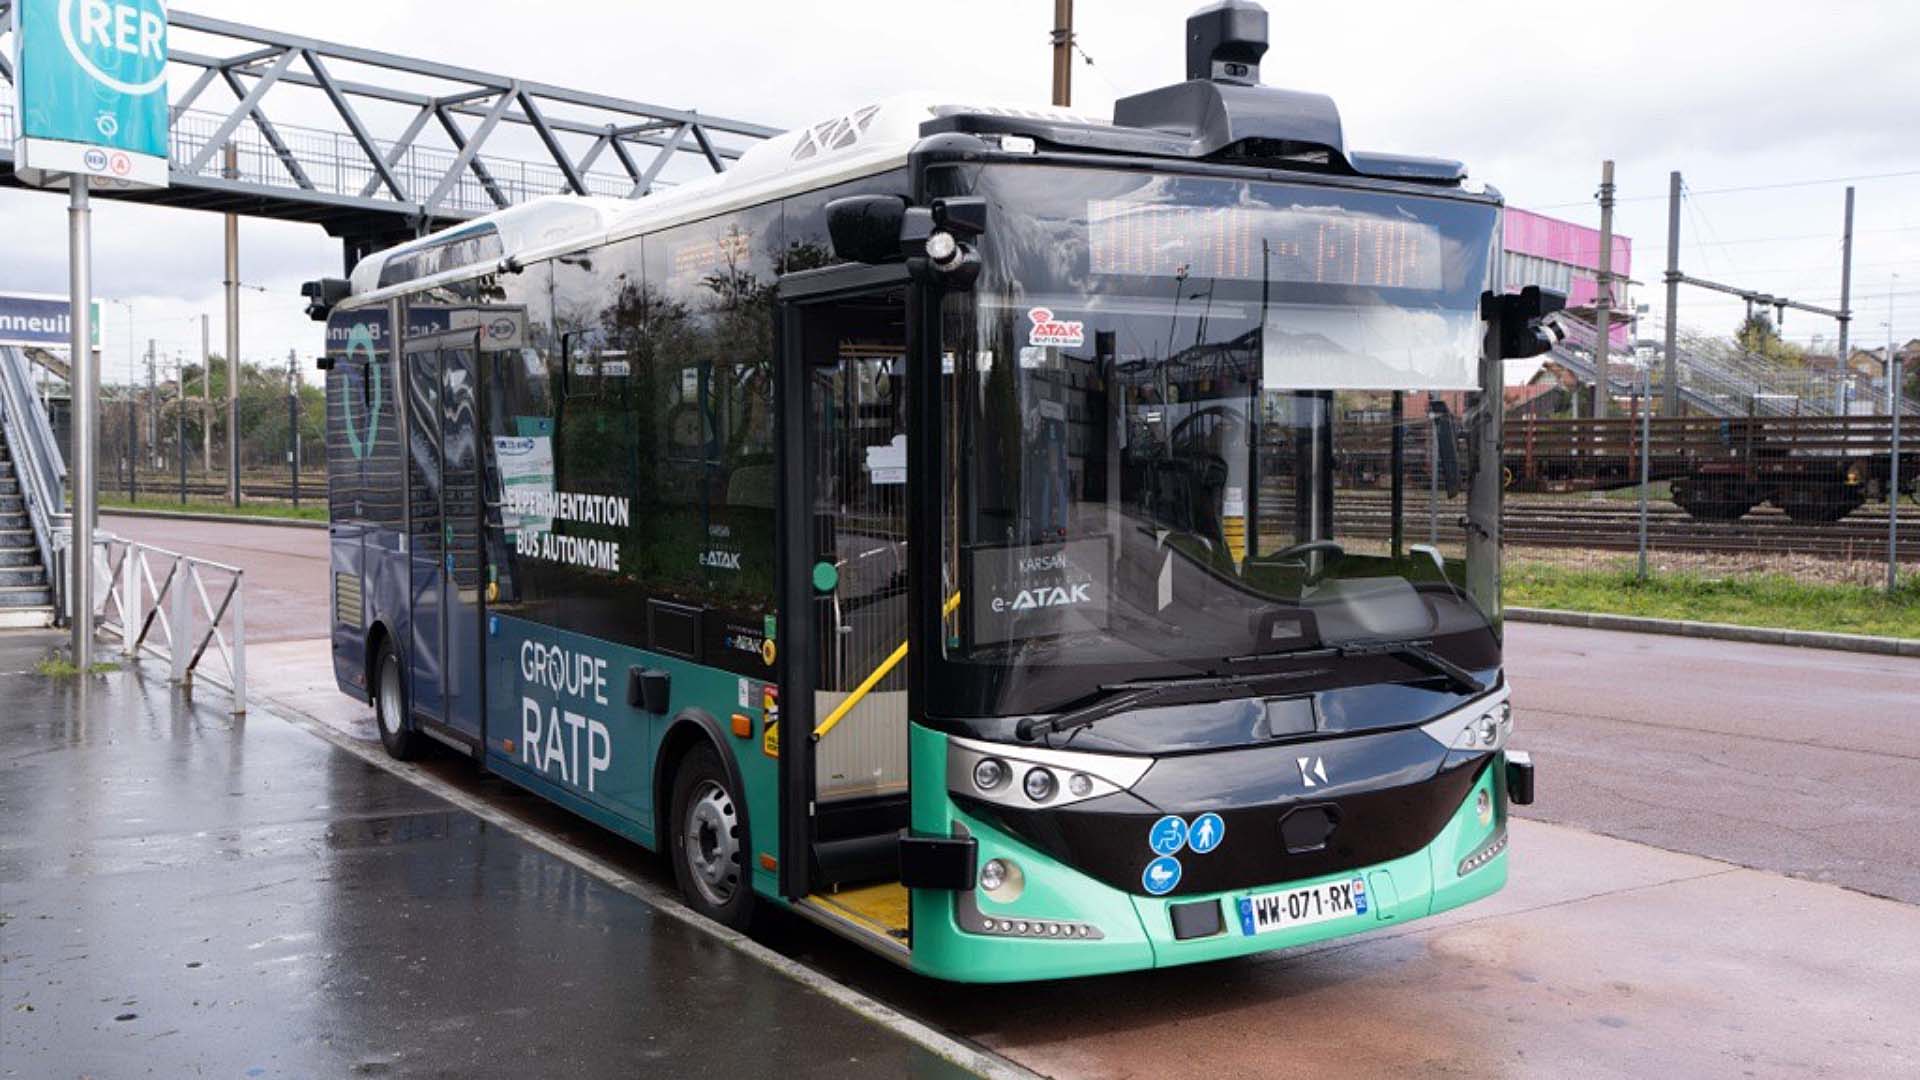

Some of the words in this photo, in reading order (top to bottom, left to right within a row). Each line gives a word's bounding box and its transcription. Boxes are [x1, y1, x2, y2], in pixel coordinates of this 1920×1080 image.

[80, 0, 164, 60] RER
[1034, 323, 1080, 337] ATAK
[516, 529, 540, 558] BUS
[542, 534, 620, 572] AUTONOME
[699, 550, 741, 570] e-ATAK
[991, 583, 1091, 612] e-ATAK
[521, 639, 609, 706] GROUPE
[522, 697, 612, 793] RATP
[1256, 883, 1354, 926] WW-071-RX
